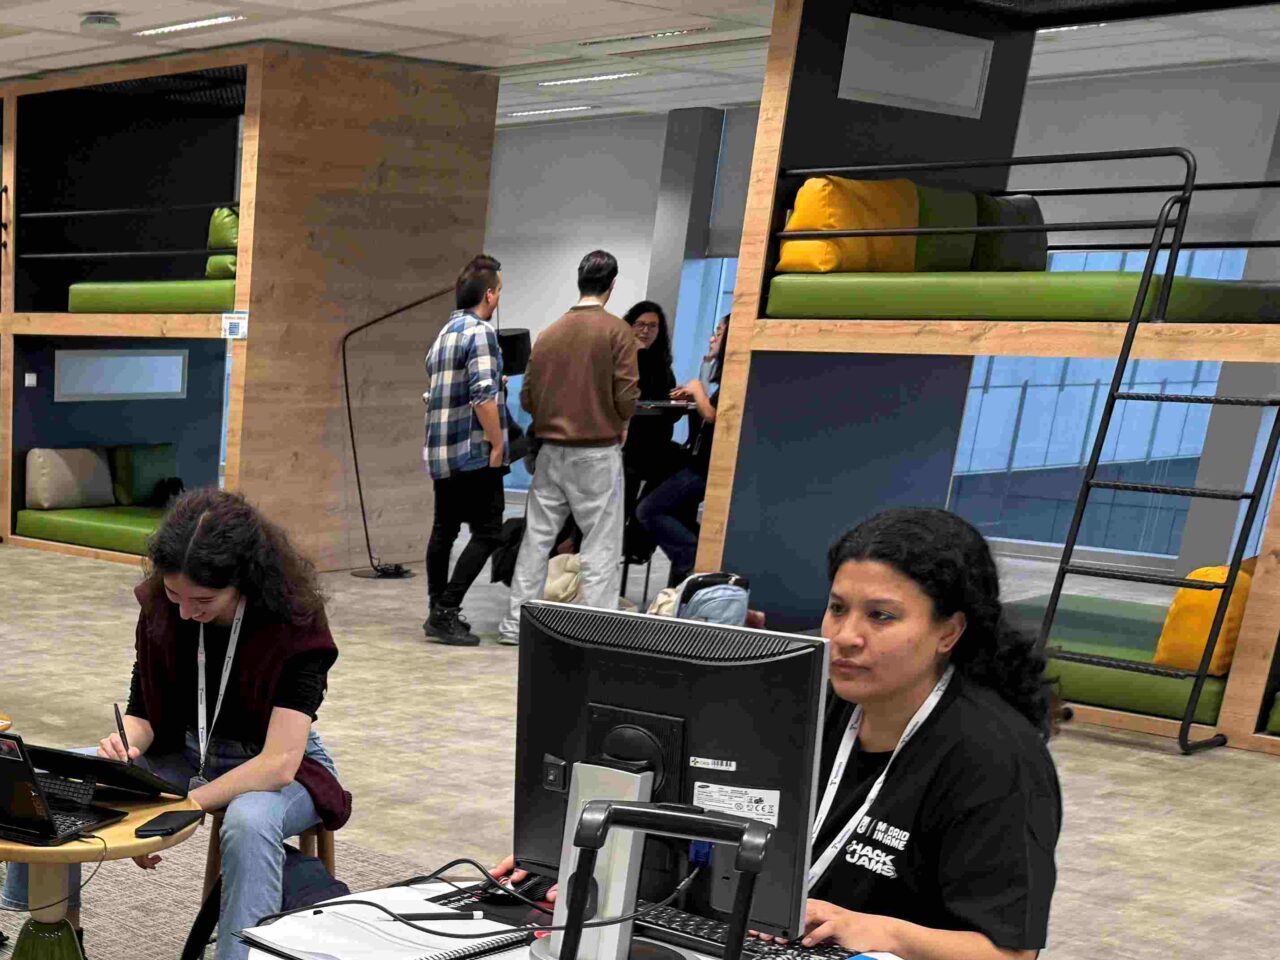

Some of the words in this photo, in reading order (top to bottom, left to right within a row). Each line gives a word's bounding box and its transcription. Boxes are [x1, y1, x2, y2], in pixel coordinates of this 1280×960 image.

[876, 821, 910, 841] MDRID
[846, 840, 896, 866] HACK
[845, 856, 898, 879] JAMS
